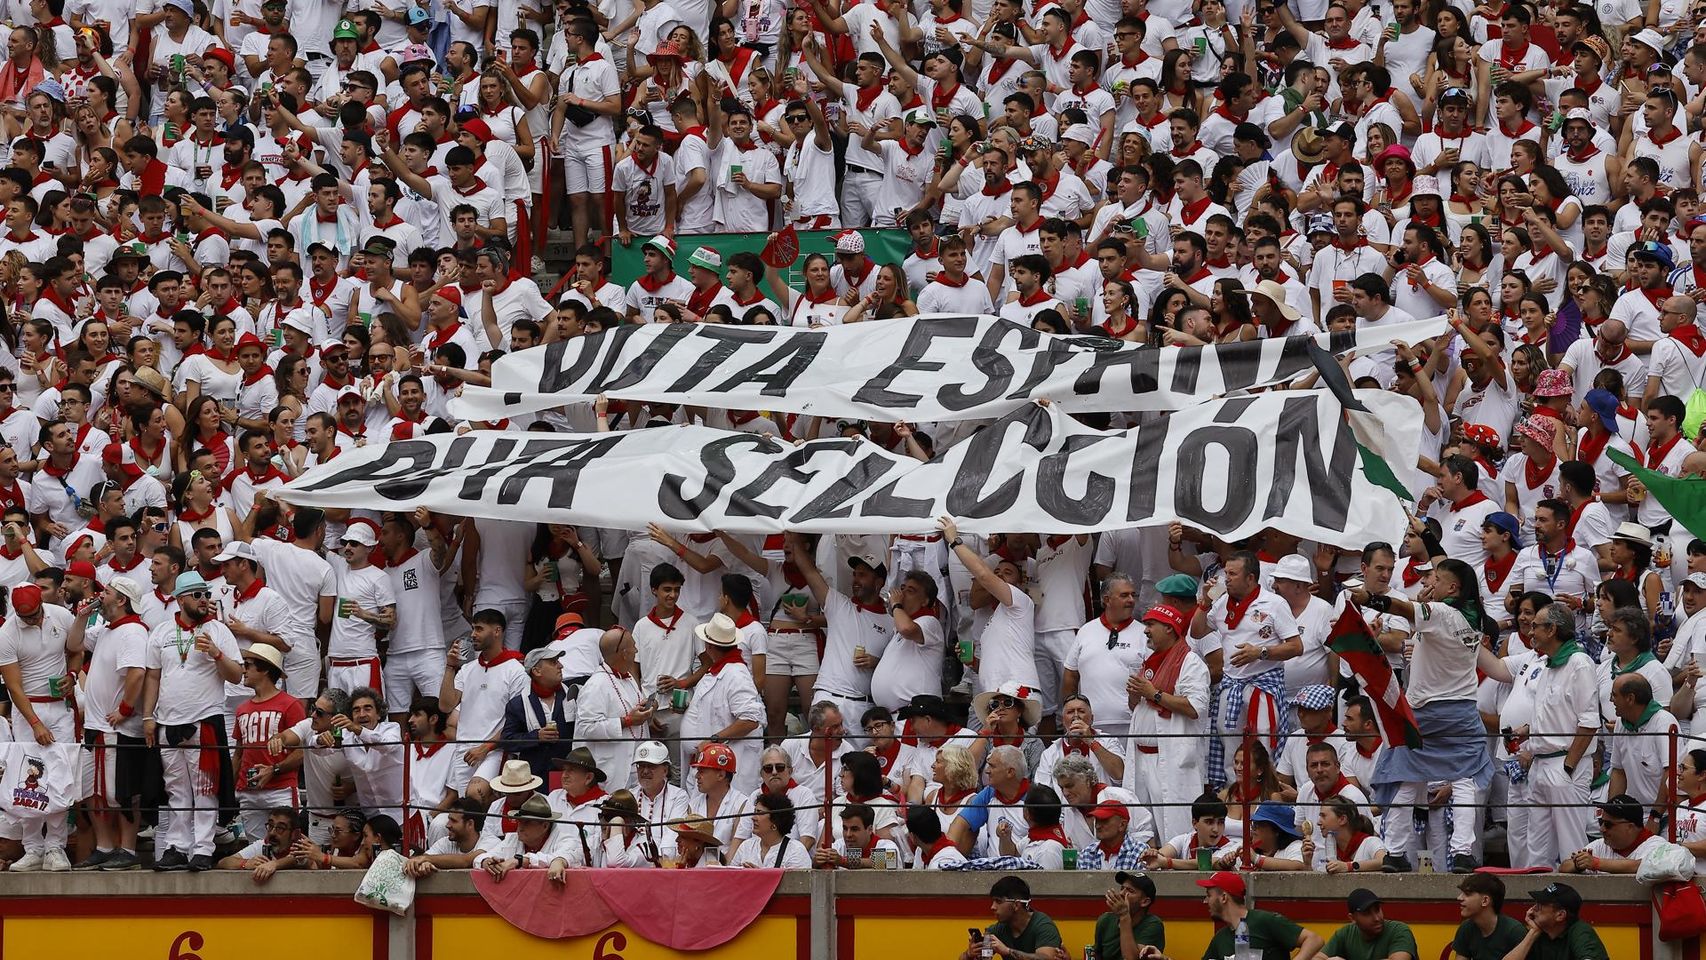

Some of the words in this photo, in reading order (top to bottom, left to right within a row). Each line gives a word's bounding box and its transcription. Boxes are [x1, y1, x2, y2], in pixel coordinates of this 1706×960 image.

[503, 323, 827, 406] PUTA
[851, 317, 1356, 407] ESPA
[404, 570, 417, 580] FCK
[13, 797, 39, 809] ZARA
